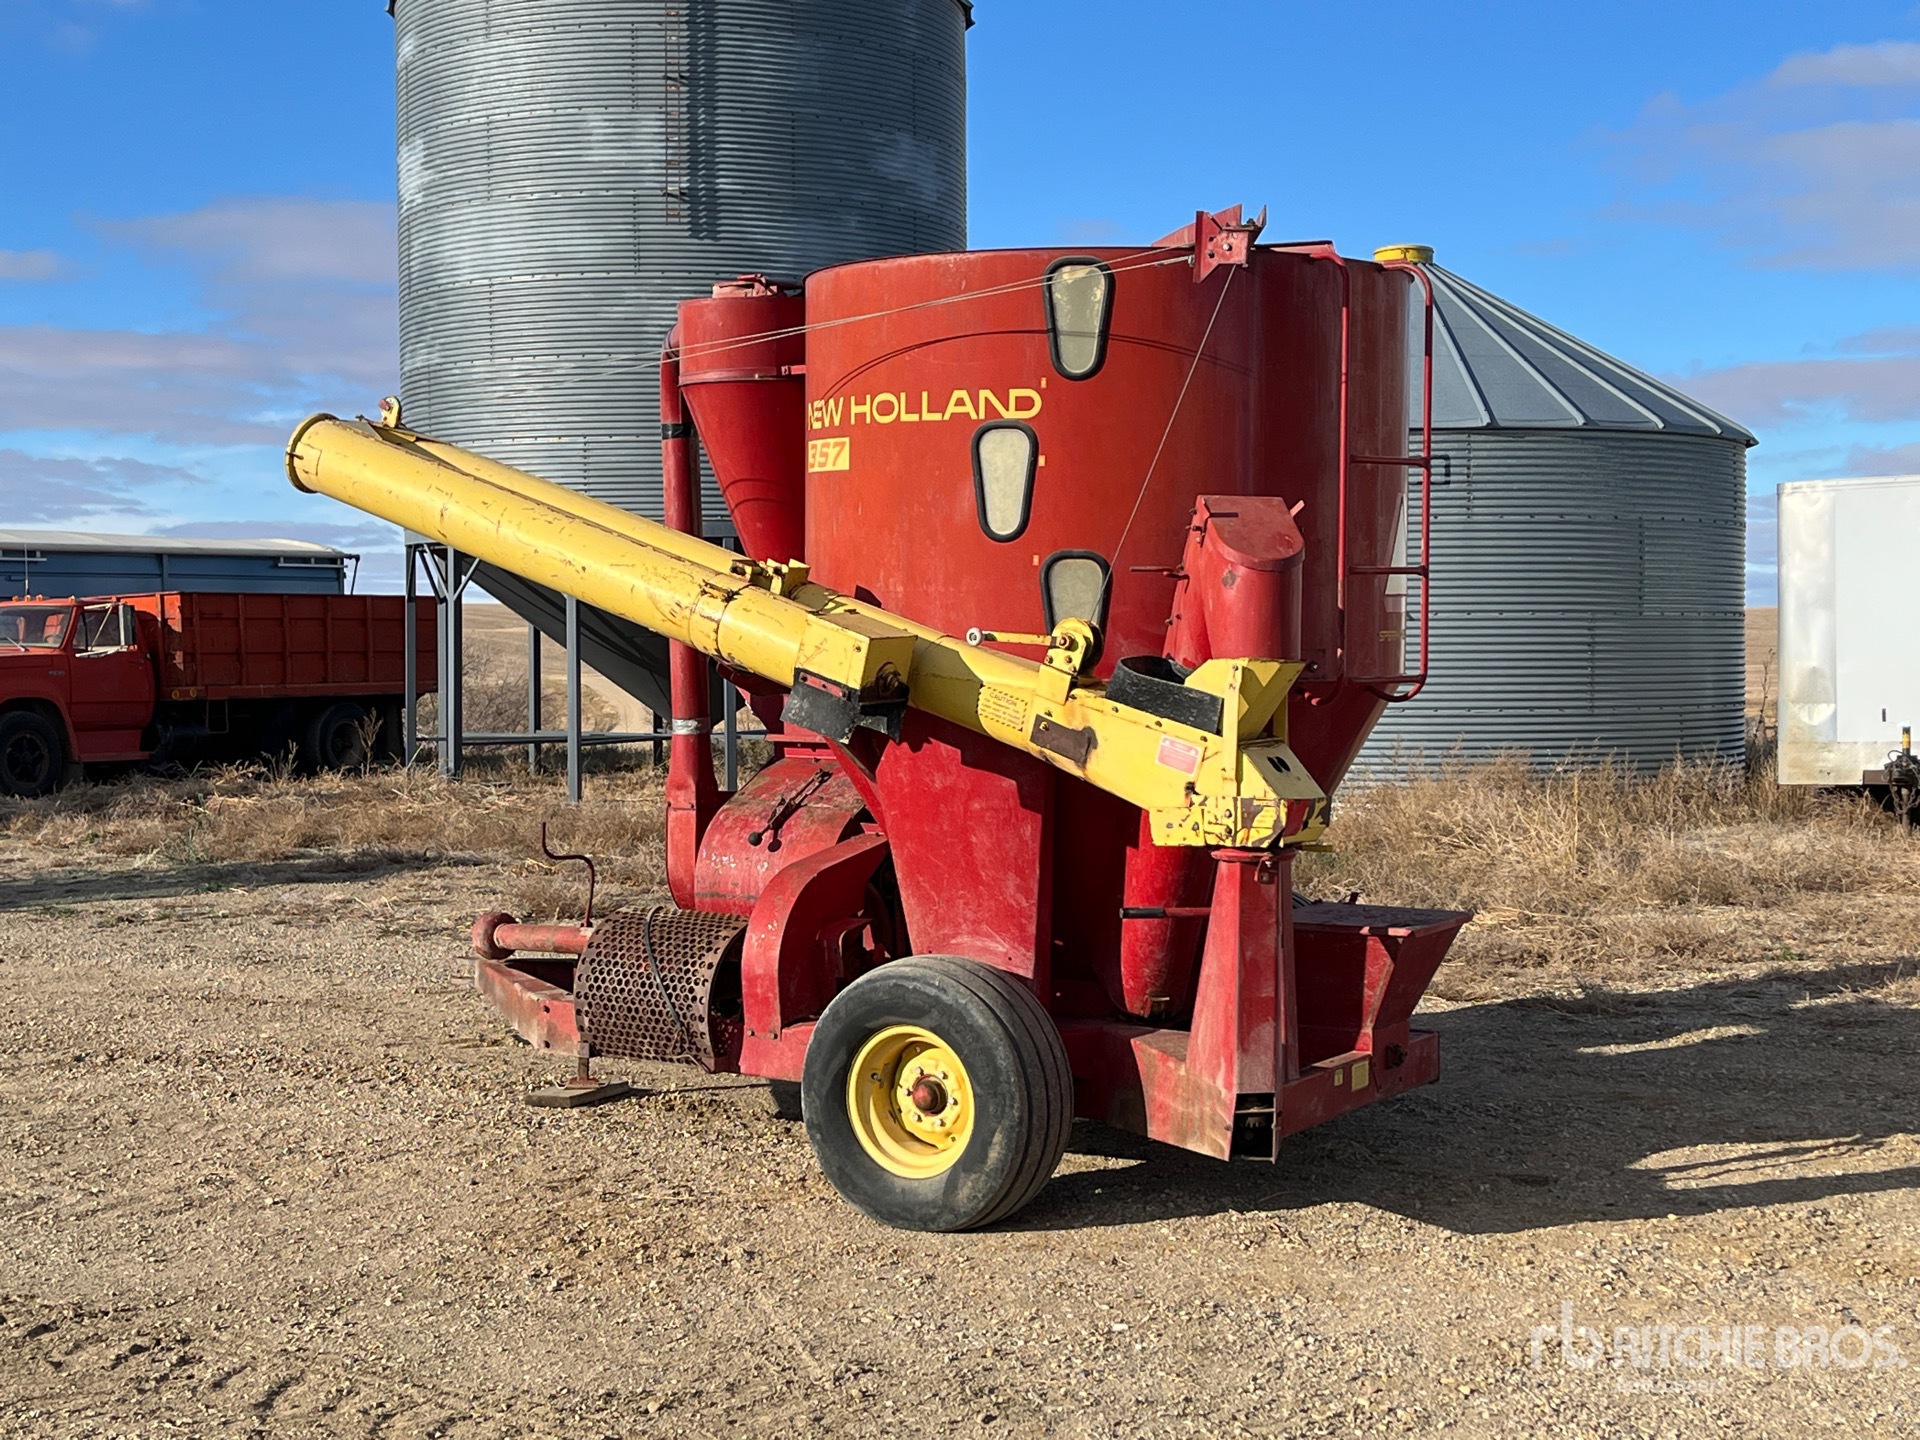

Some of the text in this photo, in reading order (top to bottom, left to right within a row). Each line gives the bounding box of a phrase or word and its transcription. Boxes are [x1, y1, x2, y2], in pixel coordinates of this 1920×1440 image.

[808, 388, 1042, 431] NEW HOLLAND
[809, 441, 847, 469] 357
